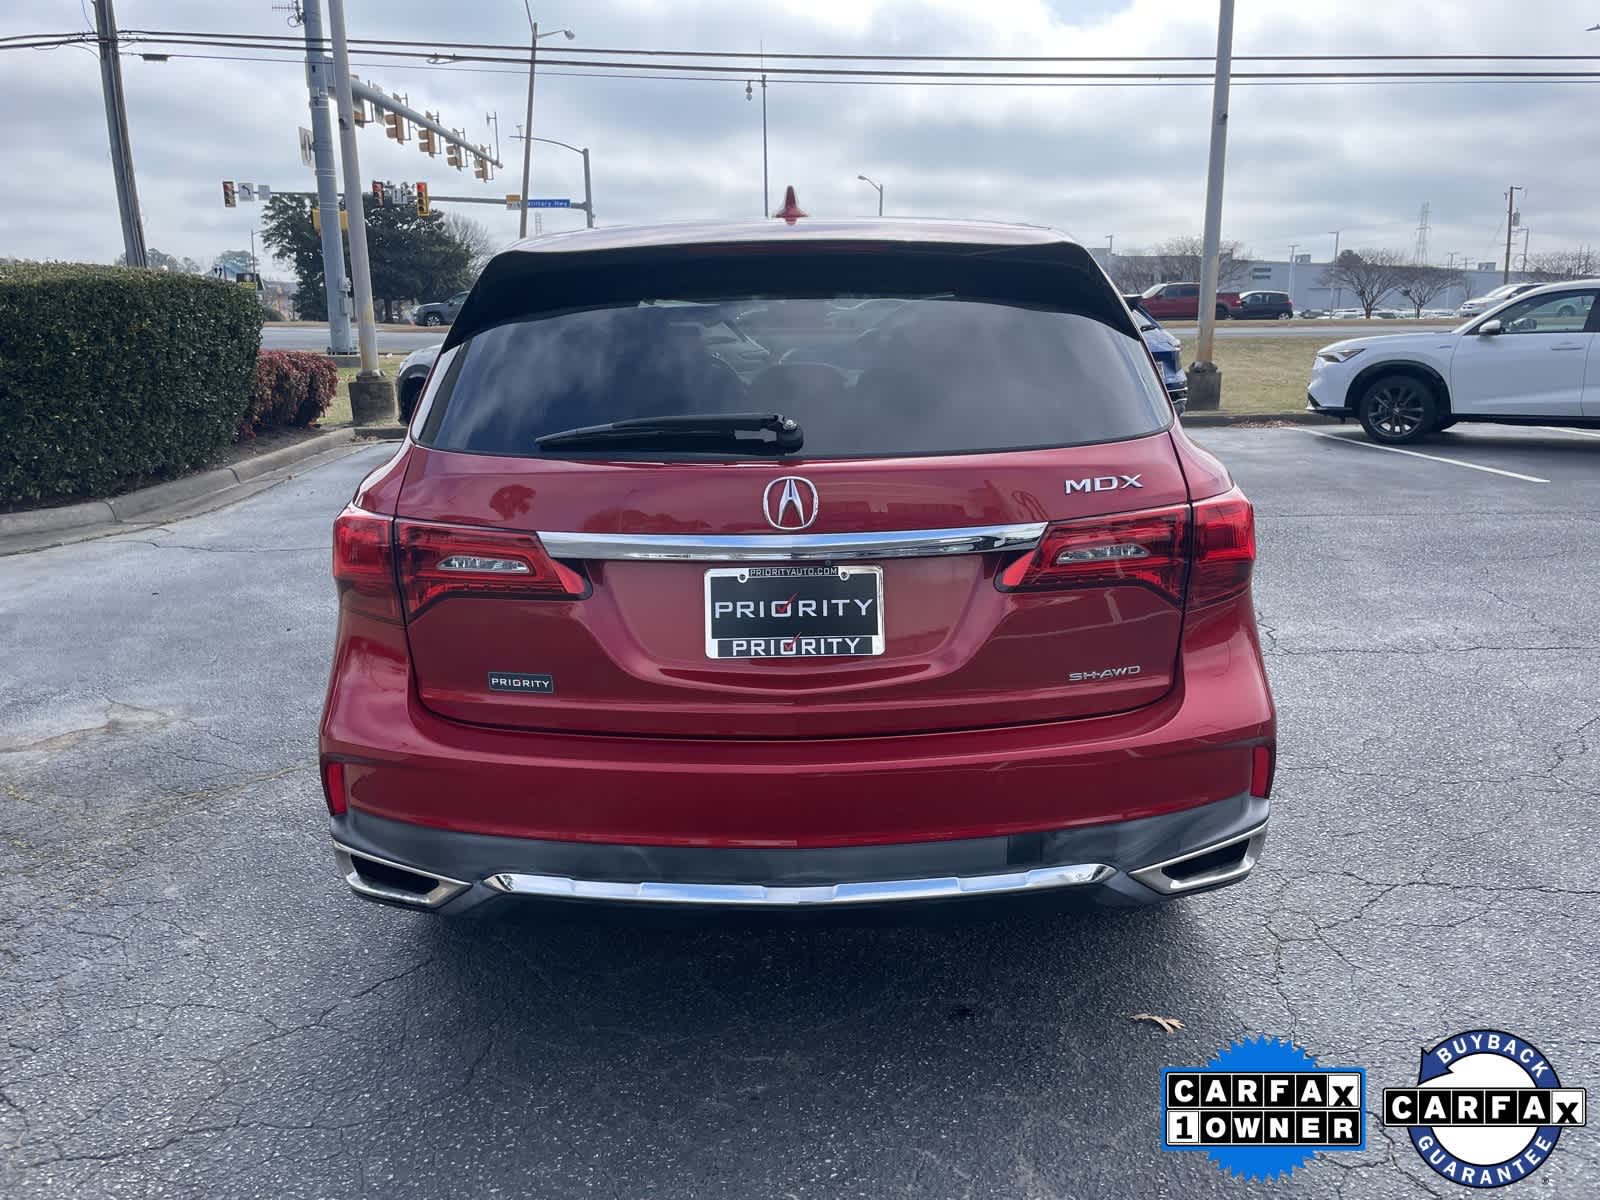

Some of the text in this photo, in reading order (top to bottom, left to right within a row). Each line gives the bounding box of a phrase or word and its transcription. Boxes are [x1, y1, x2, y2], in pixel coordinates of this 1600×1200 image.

[1065, 474, 1143, 495] MDX
[750, 567, 838, 576] PRIORITYAUTO.COM
[715, 599, 873, 618] PRIORITY
[732, 638, 860, 656] PRIORITY
[1068, 665, 1141, 681] SH-AWD
[491, 677, 550, 688] PRIORITY
